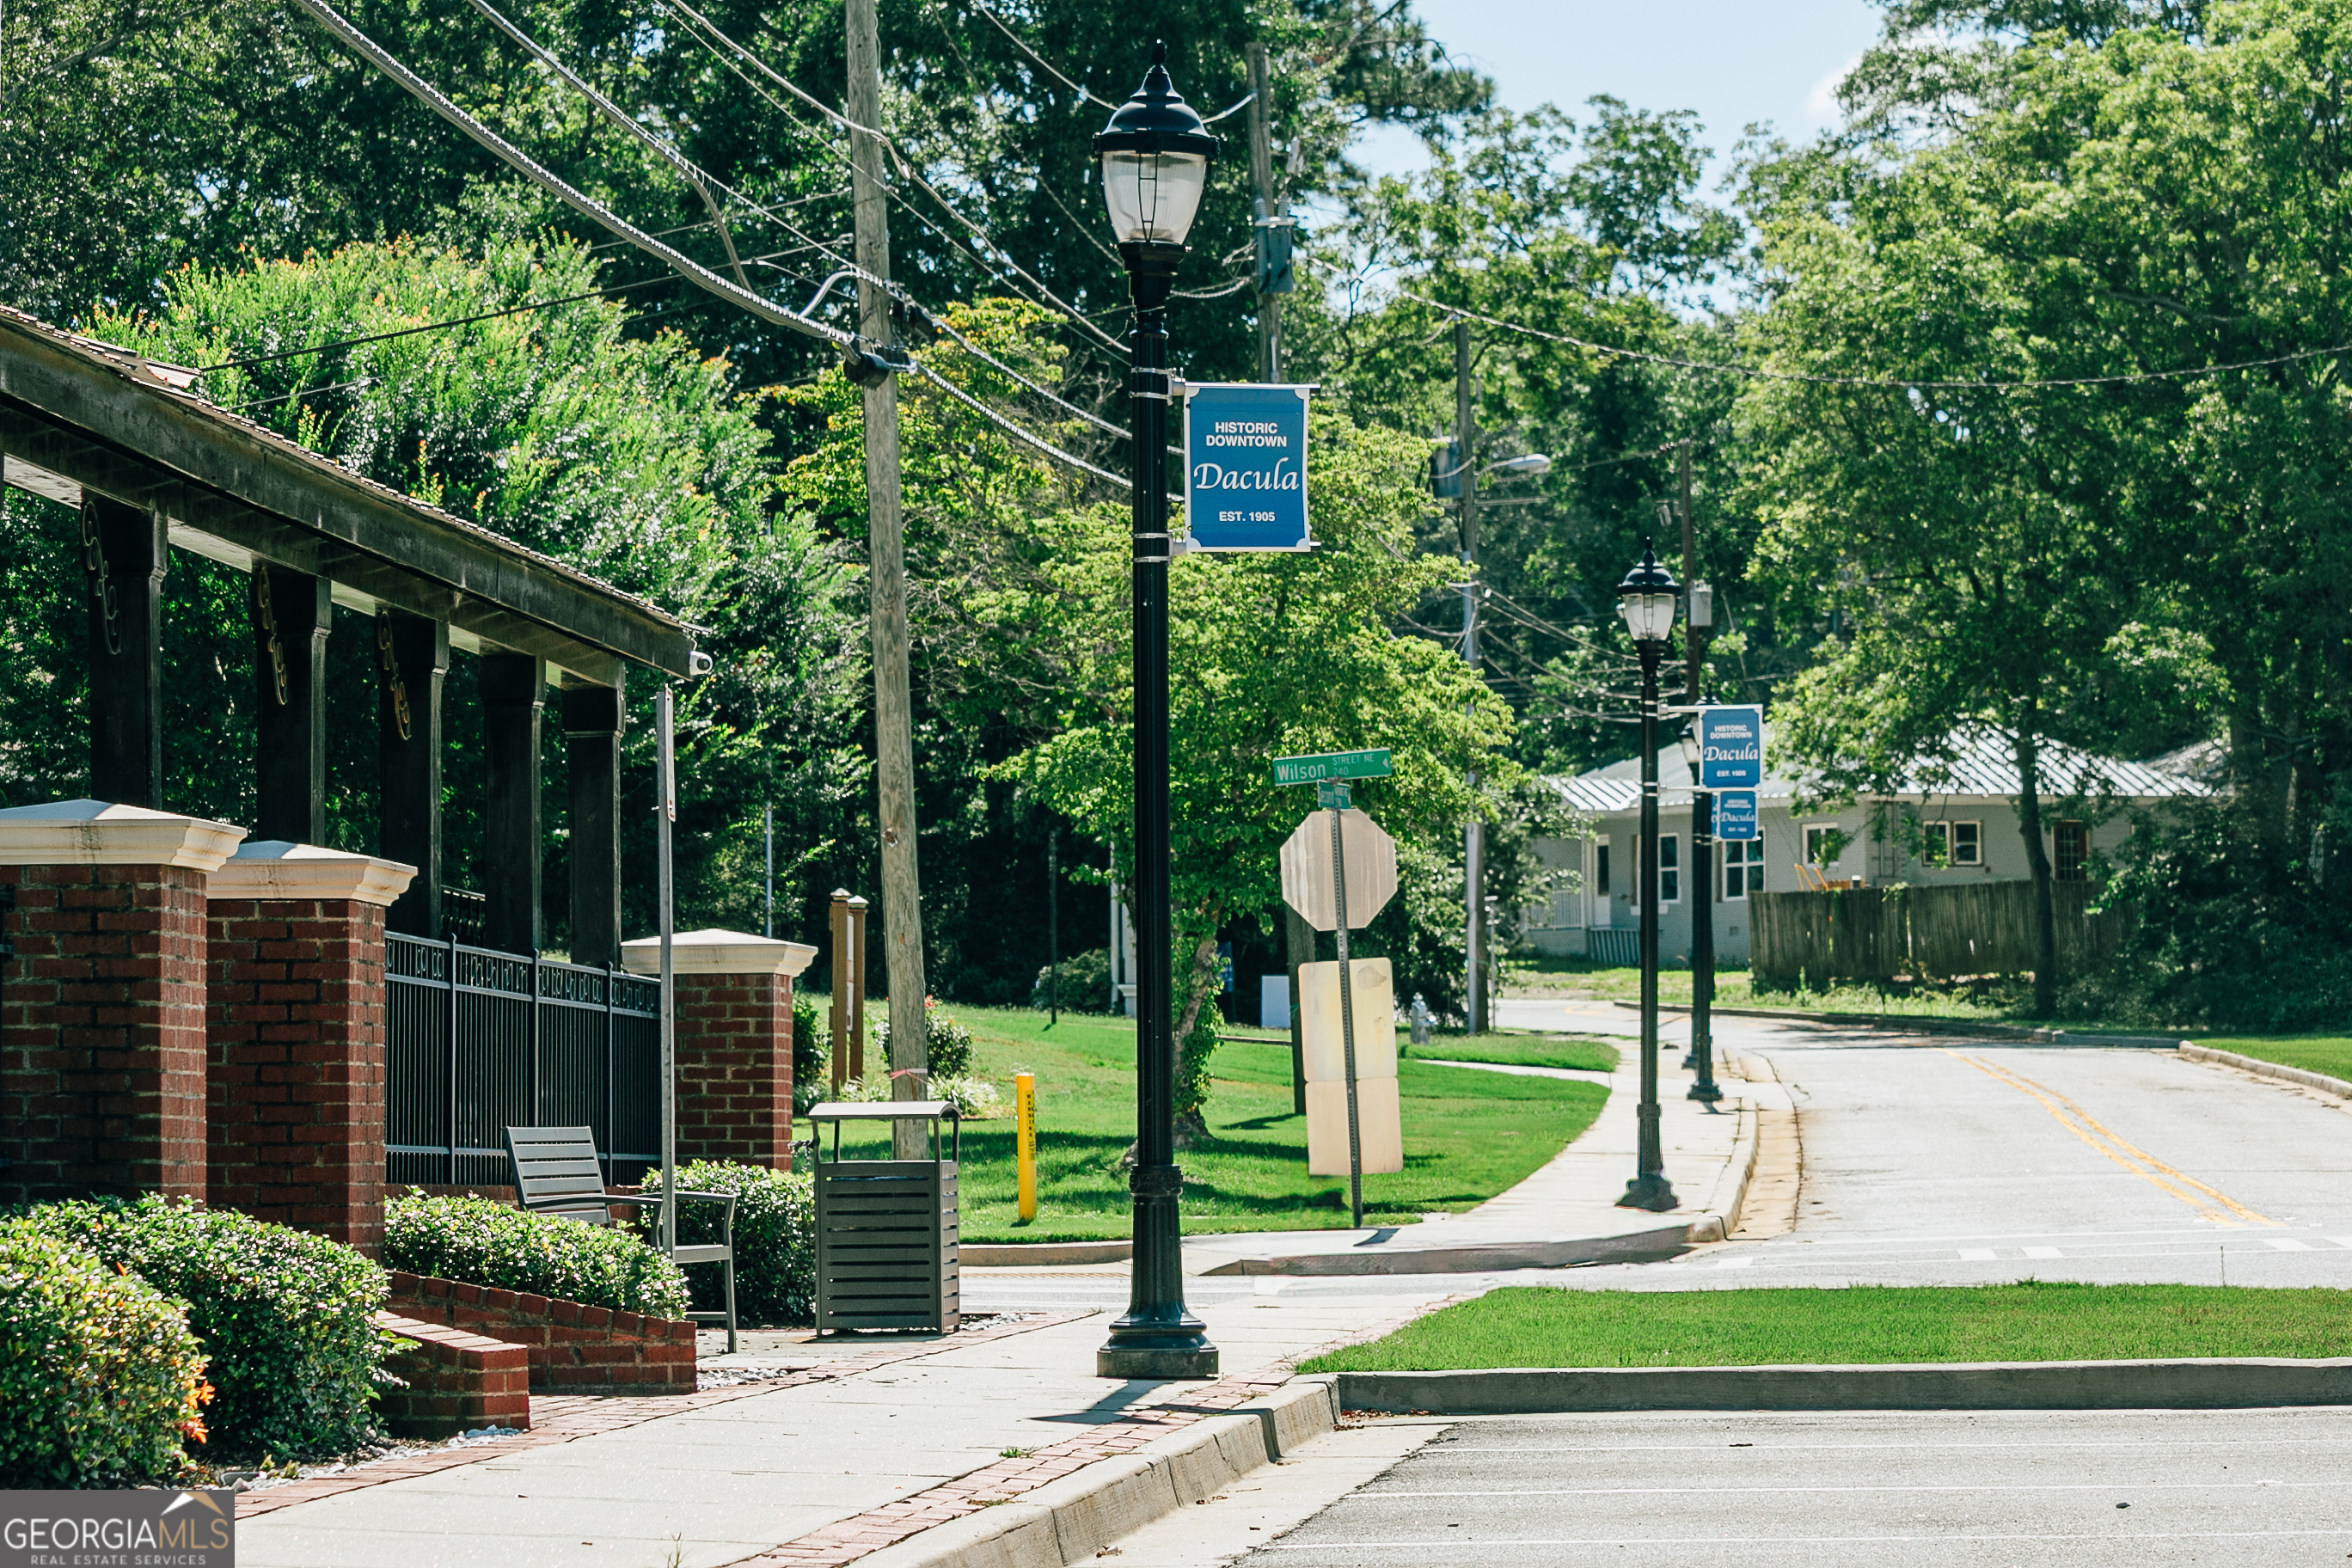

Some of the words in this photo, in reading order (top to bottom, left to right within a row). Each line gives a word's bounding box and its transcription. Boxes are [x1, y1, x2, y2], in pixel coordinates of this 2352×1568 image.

[1215, 421, 1278, 434] HISTORIC
[1205, 435, 1288, 448] DOWNTOWN
[1193, 456, 1300, 491] Dacula
[1218, 511, 1246, 523] EST.
[1248, 511, 1276, 523] 1905
[1704, 742, 1758, 761] Dacula
[1277, 763, 1326, 781] Wilson
[1332, 755, 1360, 766] STREET
[1363, 753, 1375, 763] NE
[1333, 767, 1349, 777] 240
[1720, 811, 1755, 823] Dacula
